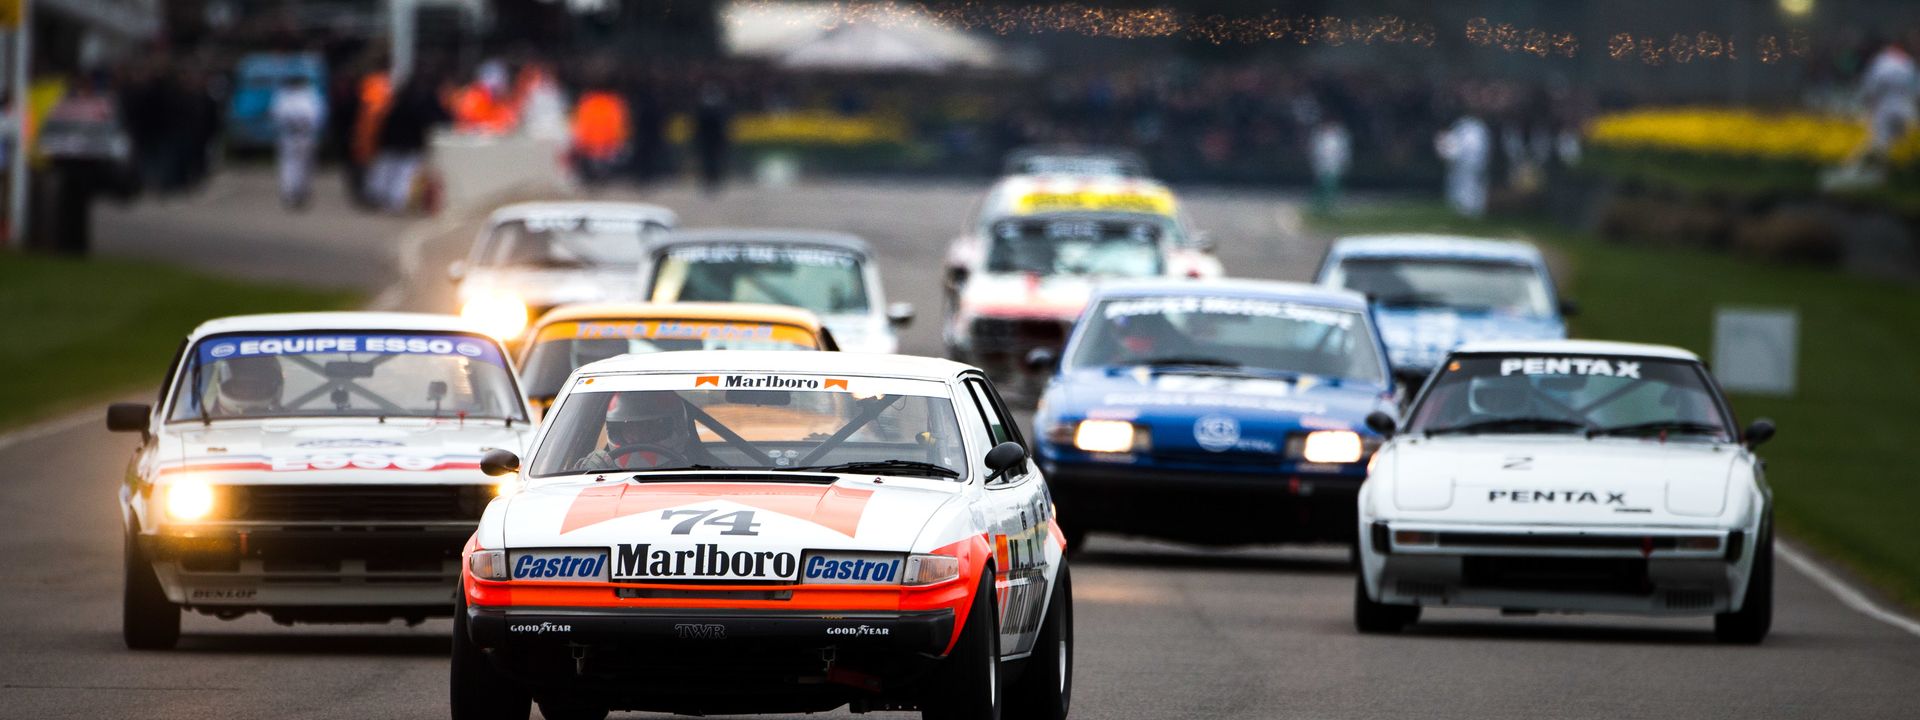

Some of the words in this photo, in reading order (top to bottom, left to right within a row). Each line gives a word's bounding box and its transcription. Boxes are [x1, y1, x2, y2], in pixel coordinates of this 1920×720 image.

[577, 323, 647, 338] Track
[654, 322, 773, 338] Marshall
[240, 338, 356, 354] EQUIPE
[366, 338, 453, 354] ESSO
[1501, 358, 1641, 379] PENTAX
[725, 376, 818, 389] Marlboro
[272, 454, 438, 471] ESSO
[1502, 456, 1534, 470] 2
[1488, 490, 1625, 504] PENTAX
[661, 509, 761, 536] 74
[514, 554, 607, 578] Castrol
[615, 543, 795, 577] Marlboro
[806, 555, 900, 582] Castrol
[193, 590, 257, 598] DUNLOP
[675, 623, 727, 639] TWR
